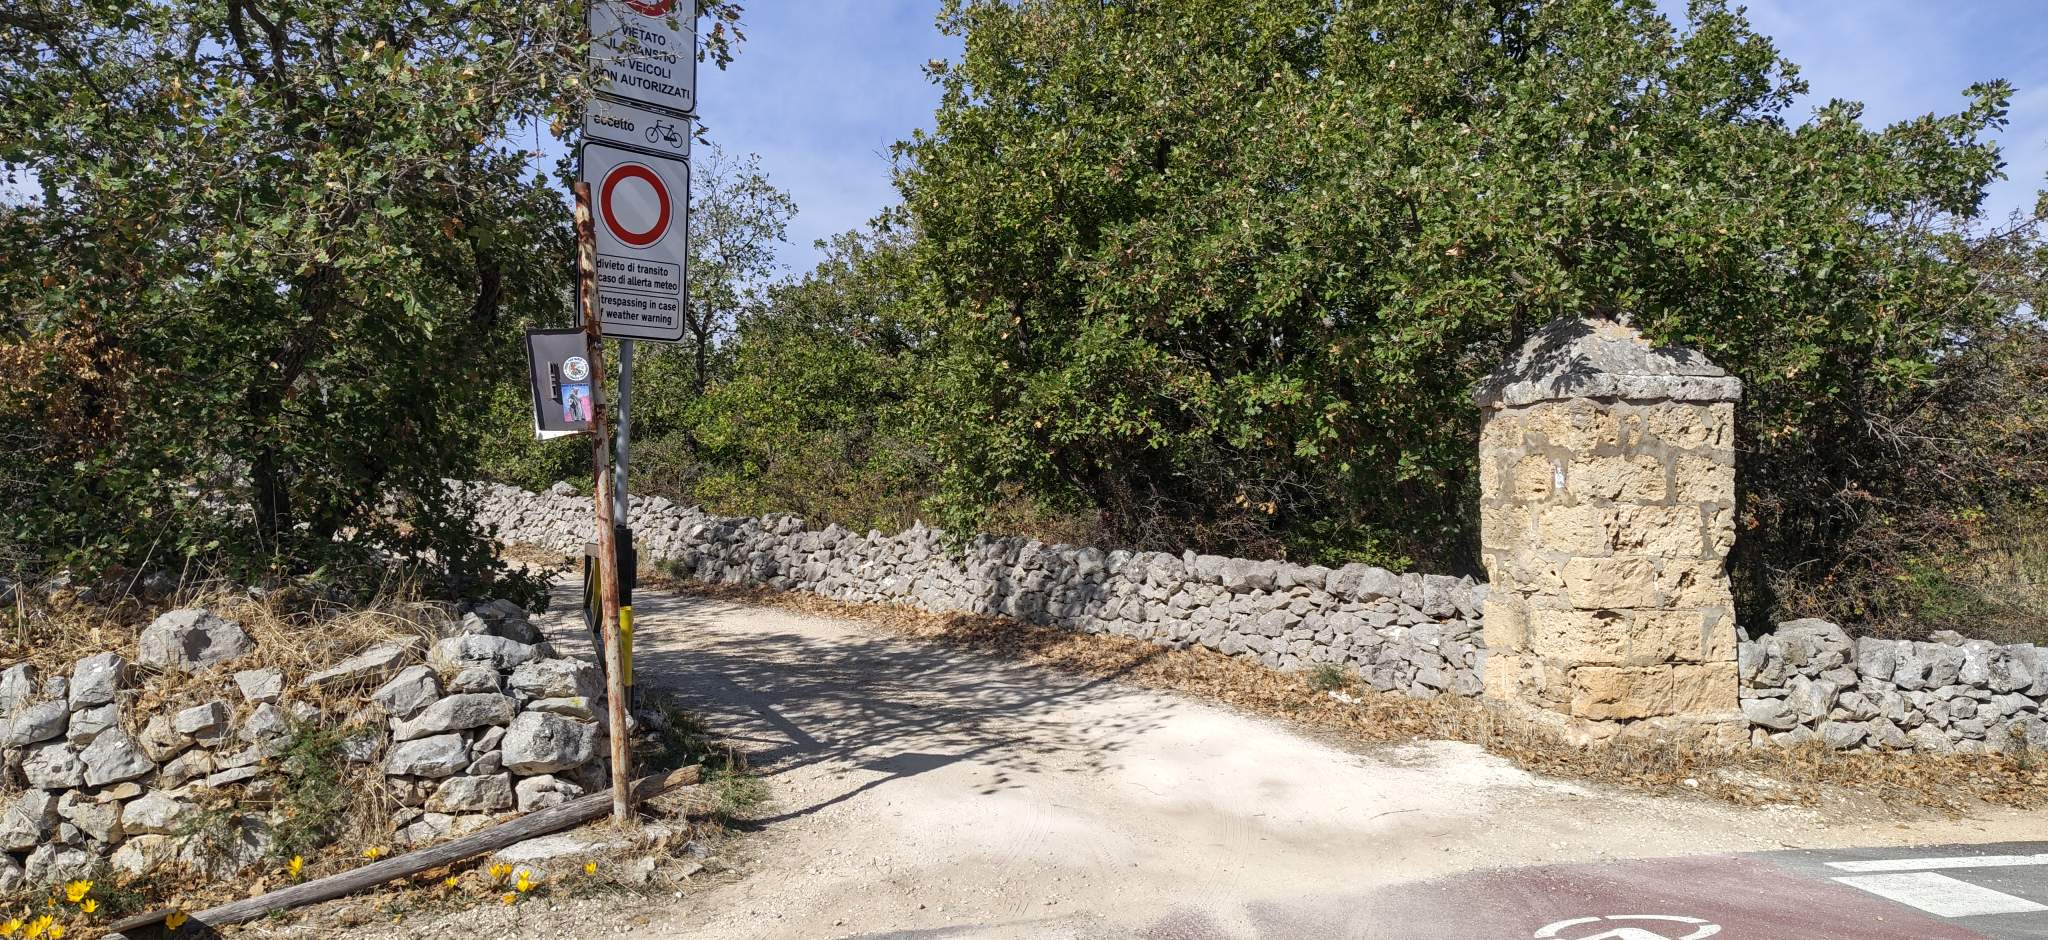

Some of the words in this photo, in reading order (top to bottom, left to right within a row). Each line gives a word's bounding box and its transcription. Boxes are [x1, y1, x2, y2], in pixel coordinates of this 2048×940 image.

[621, 24, 666, 46] VIETATO
[609, 38, 619, 49] IL
[625, 43, 677, 65] RANSITO
[629, 59, 671, 80] VEICOLI
[593, 66, 618, 82] NON
[620, 74, 690, 100] AUTORIZZATI
[597, 259, 625, 271] divieto
[627, 262, 635, 273] di
[637, 265, 669, 277] transito
[598, 274, 617, 284] caso
[618, 275, 626, 285] di
[627, 276, 652, 288] allerta
[653, 280, 678, 291] meteo
[601, 294, 647, 309] trespassing
[649, 299, 657, 309] in
[658, 301, 677, 312] case
[605, 309, 640, 321] weather
[641, 311, 672, 326] warning
